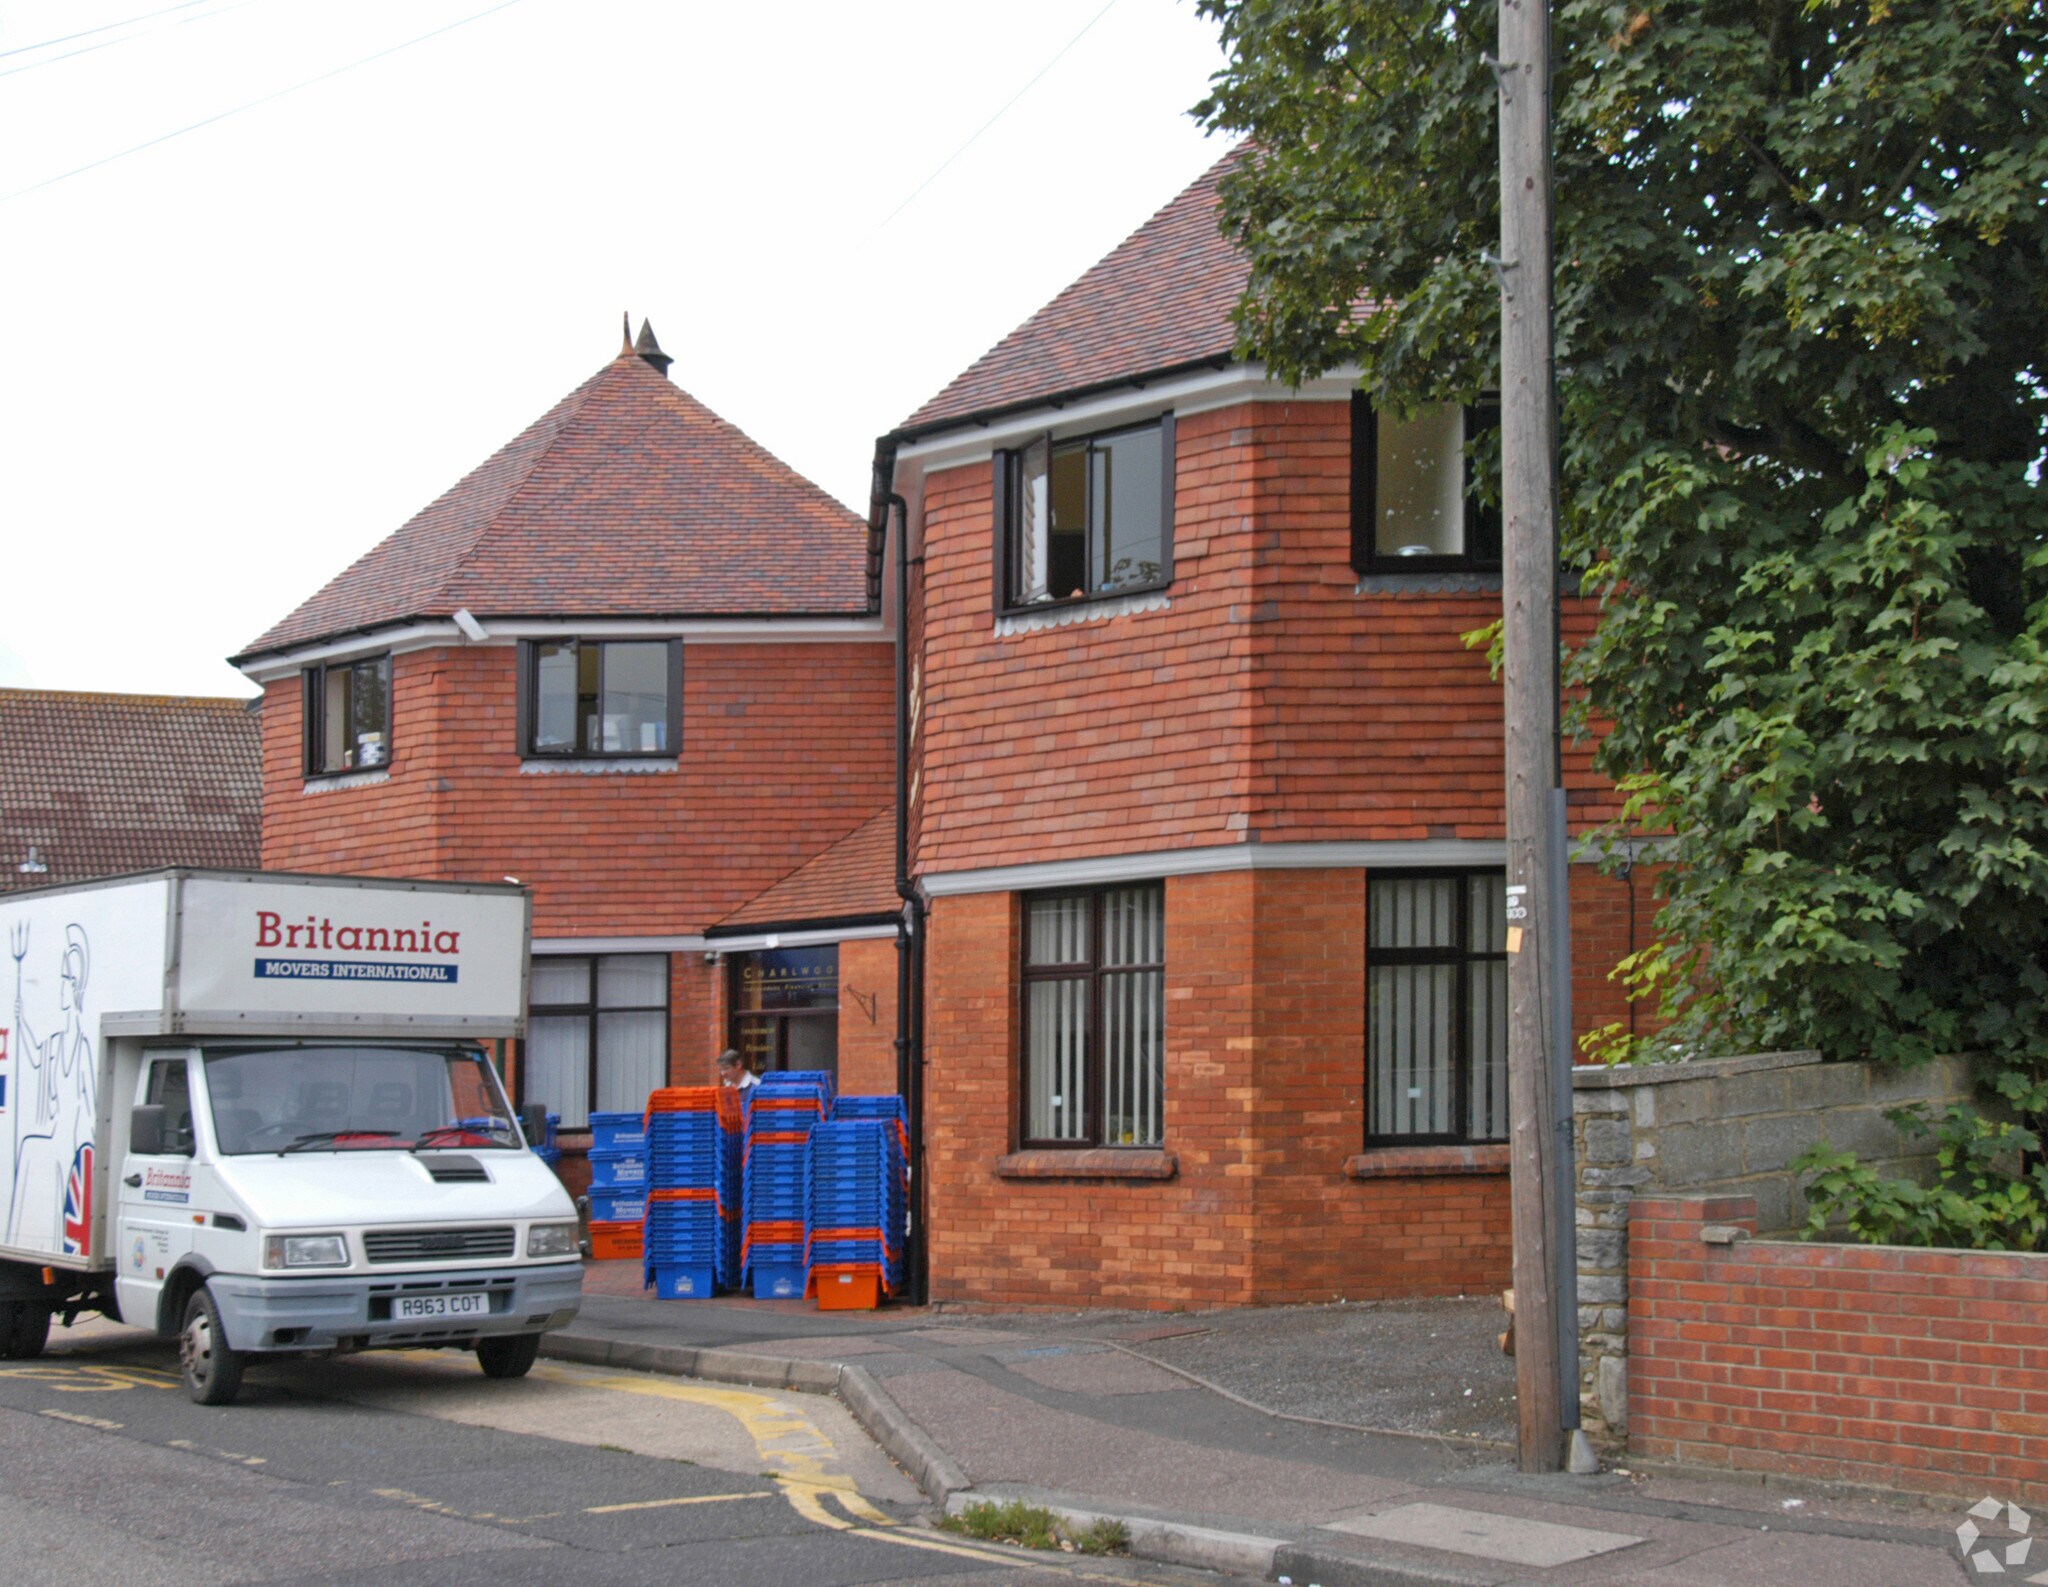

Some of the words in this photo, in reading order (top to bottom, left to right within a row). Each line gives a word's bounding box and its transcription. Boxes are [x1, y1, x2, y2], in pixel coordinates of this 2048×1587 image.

[255, 911, 460, 954] Britannia
[265, 961, 330, 977] MOVERS
[333, 963, 448, 980] INTERNATIONAL
[146, 1167, 192, 1189] Britannia
[402, 1299, 446, 1316] R963
[450, 1295, 482, 1313] COT
